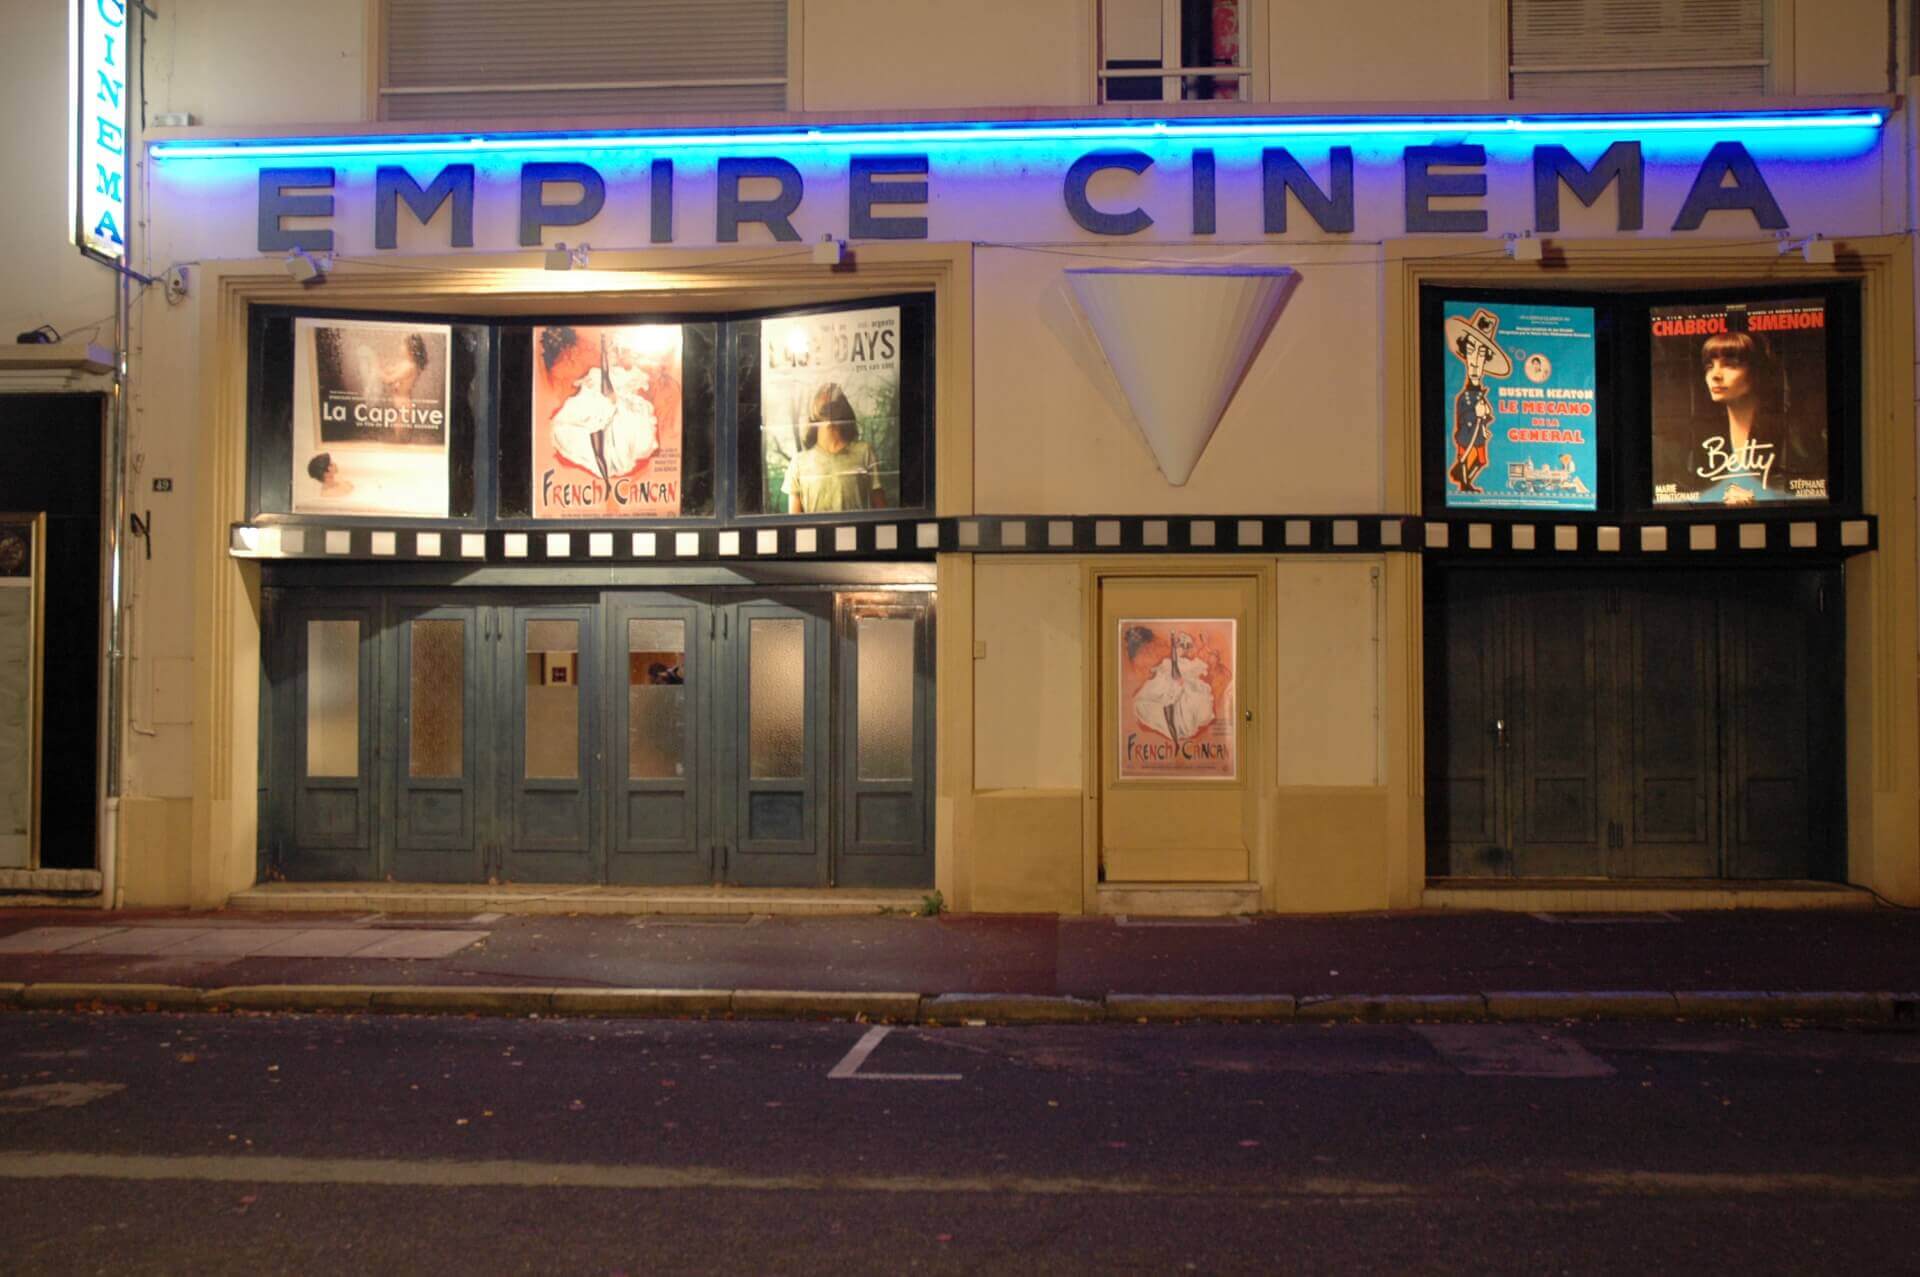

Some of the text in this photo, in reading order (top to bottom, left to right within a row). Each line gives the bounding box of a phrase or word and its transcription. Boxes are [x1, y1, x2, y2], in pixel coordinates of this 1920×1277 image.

[94, 0, 124, 245] CINEMA
[257, 141, 1789, 251] EMPIRE CINEMA
[1652, 312, 1824, 336] CHABROL SIMENON
[834, 330, 895, 362] DAYS
[1499, 387, 1594, 400] BUSTER KEATON
[323, 402, 444, 428] La Captive
[1499, 400, 1592, 416] LE MECANO
[1507, 428, 1585, 444] GENERAL
[1696, 436, 1775, 490] Betty
[614, 478, 677, 505] CANCAN
